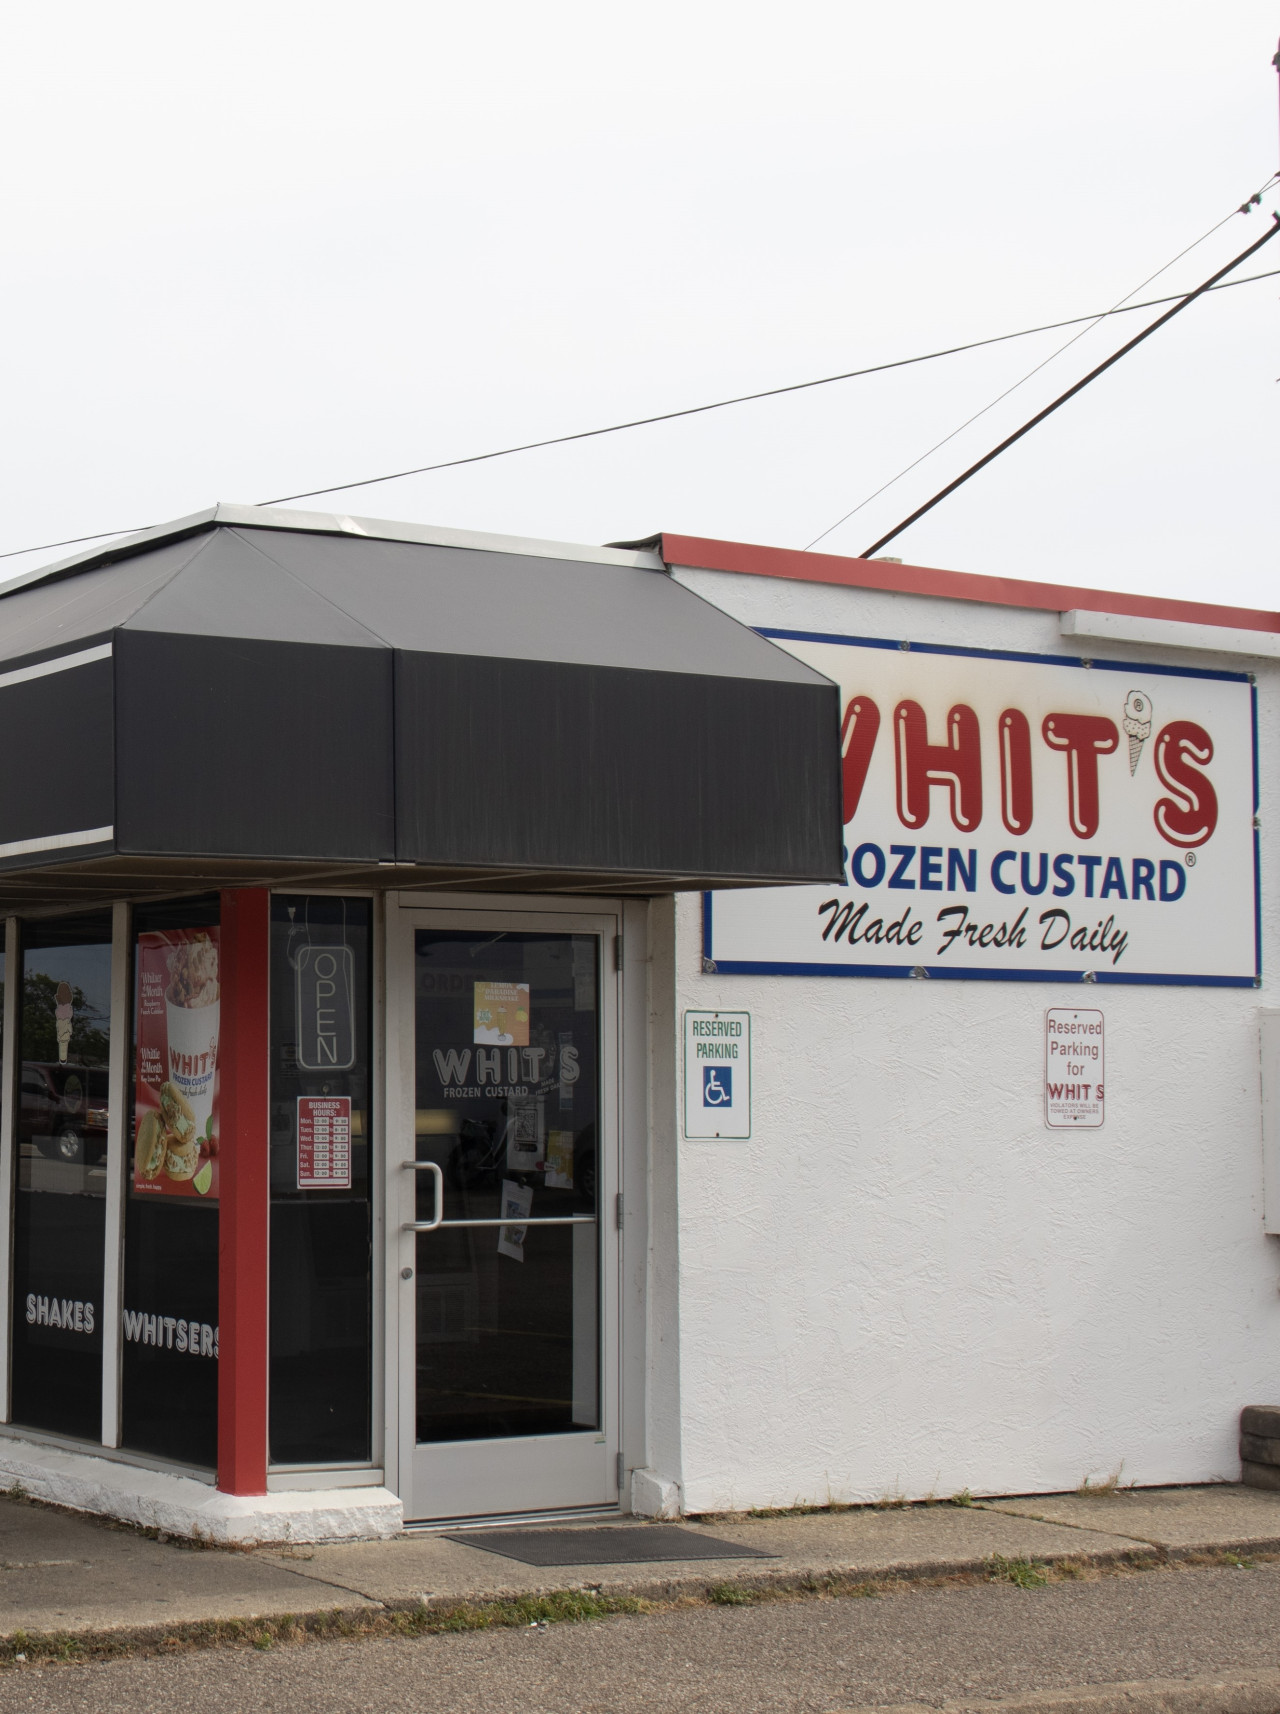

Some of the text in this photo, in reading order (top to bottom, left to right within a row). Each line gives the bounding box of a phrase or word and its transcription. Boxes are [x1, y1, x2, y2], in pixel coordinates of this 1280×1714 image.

[841, 690, 1219, 848] HIT'S
[839, 842, 1186, 902] OZEN CUSTARD
[818, 898, 1129, 965] Made Fresh Daily
[314, 953, 337, 1064] OPEN
[692, 1020, 742, 1037] RESERVED
[1048, 1019, 1102, 1034] Reserved
[696, 1043, 738, 1059] PARKING
[1050, 1041, 1099, 1060] Parking
[1067, 1061, 1085, 1076] for
[443, 1086, 529, 1098] FROZEN CUSTARD
[313, 1109, 336, 1117] HOURS:
[26, 1293, 95, 1335] SHAKES
